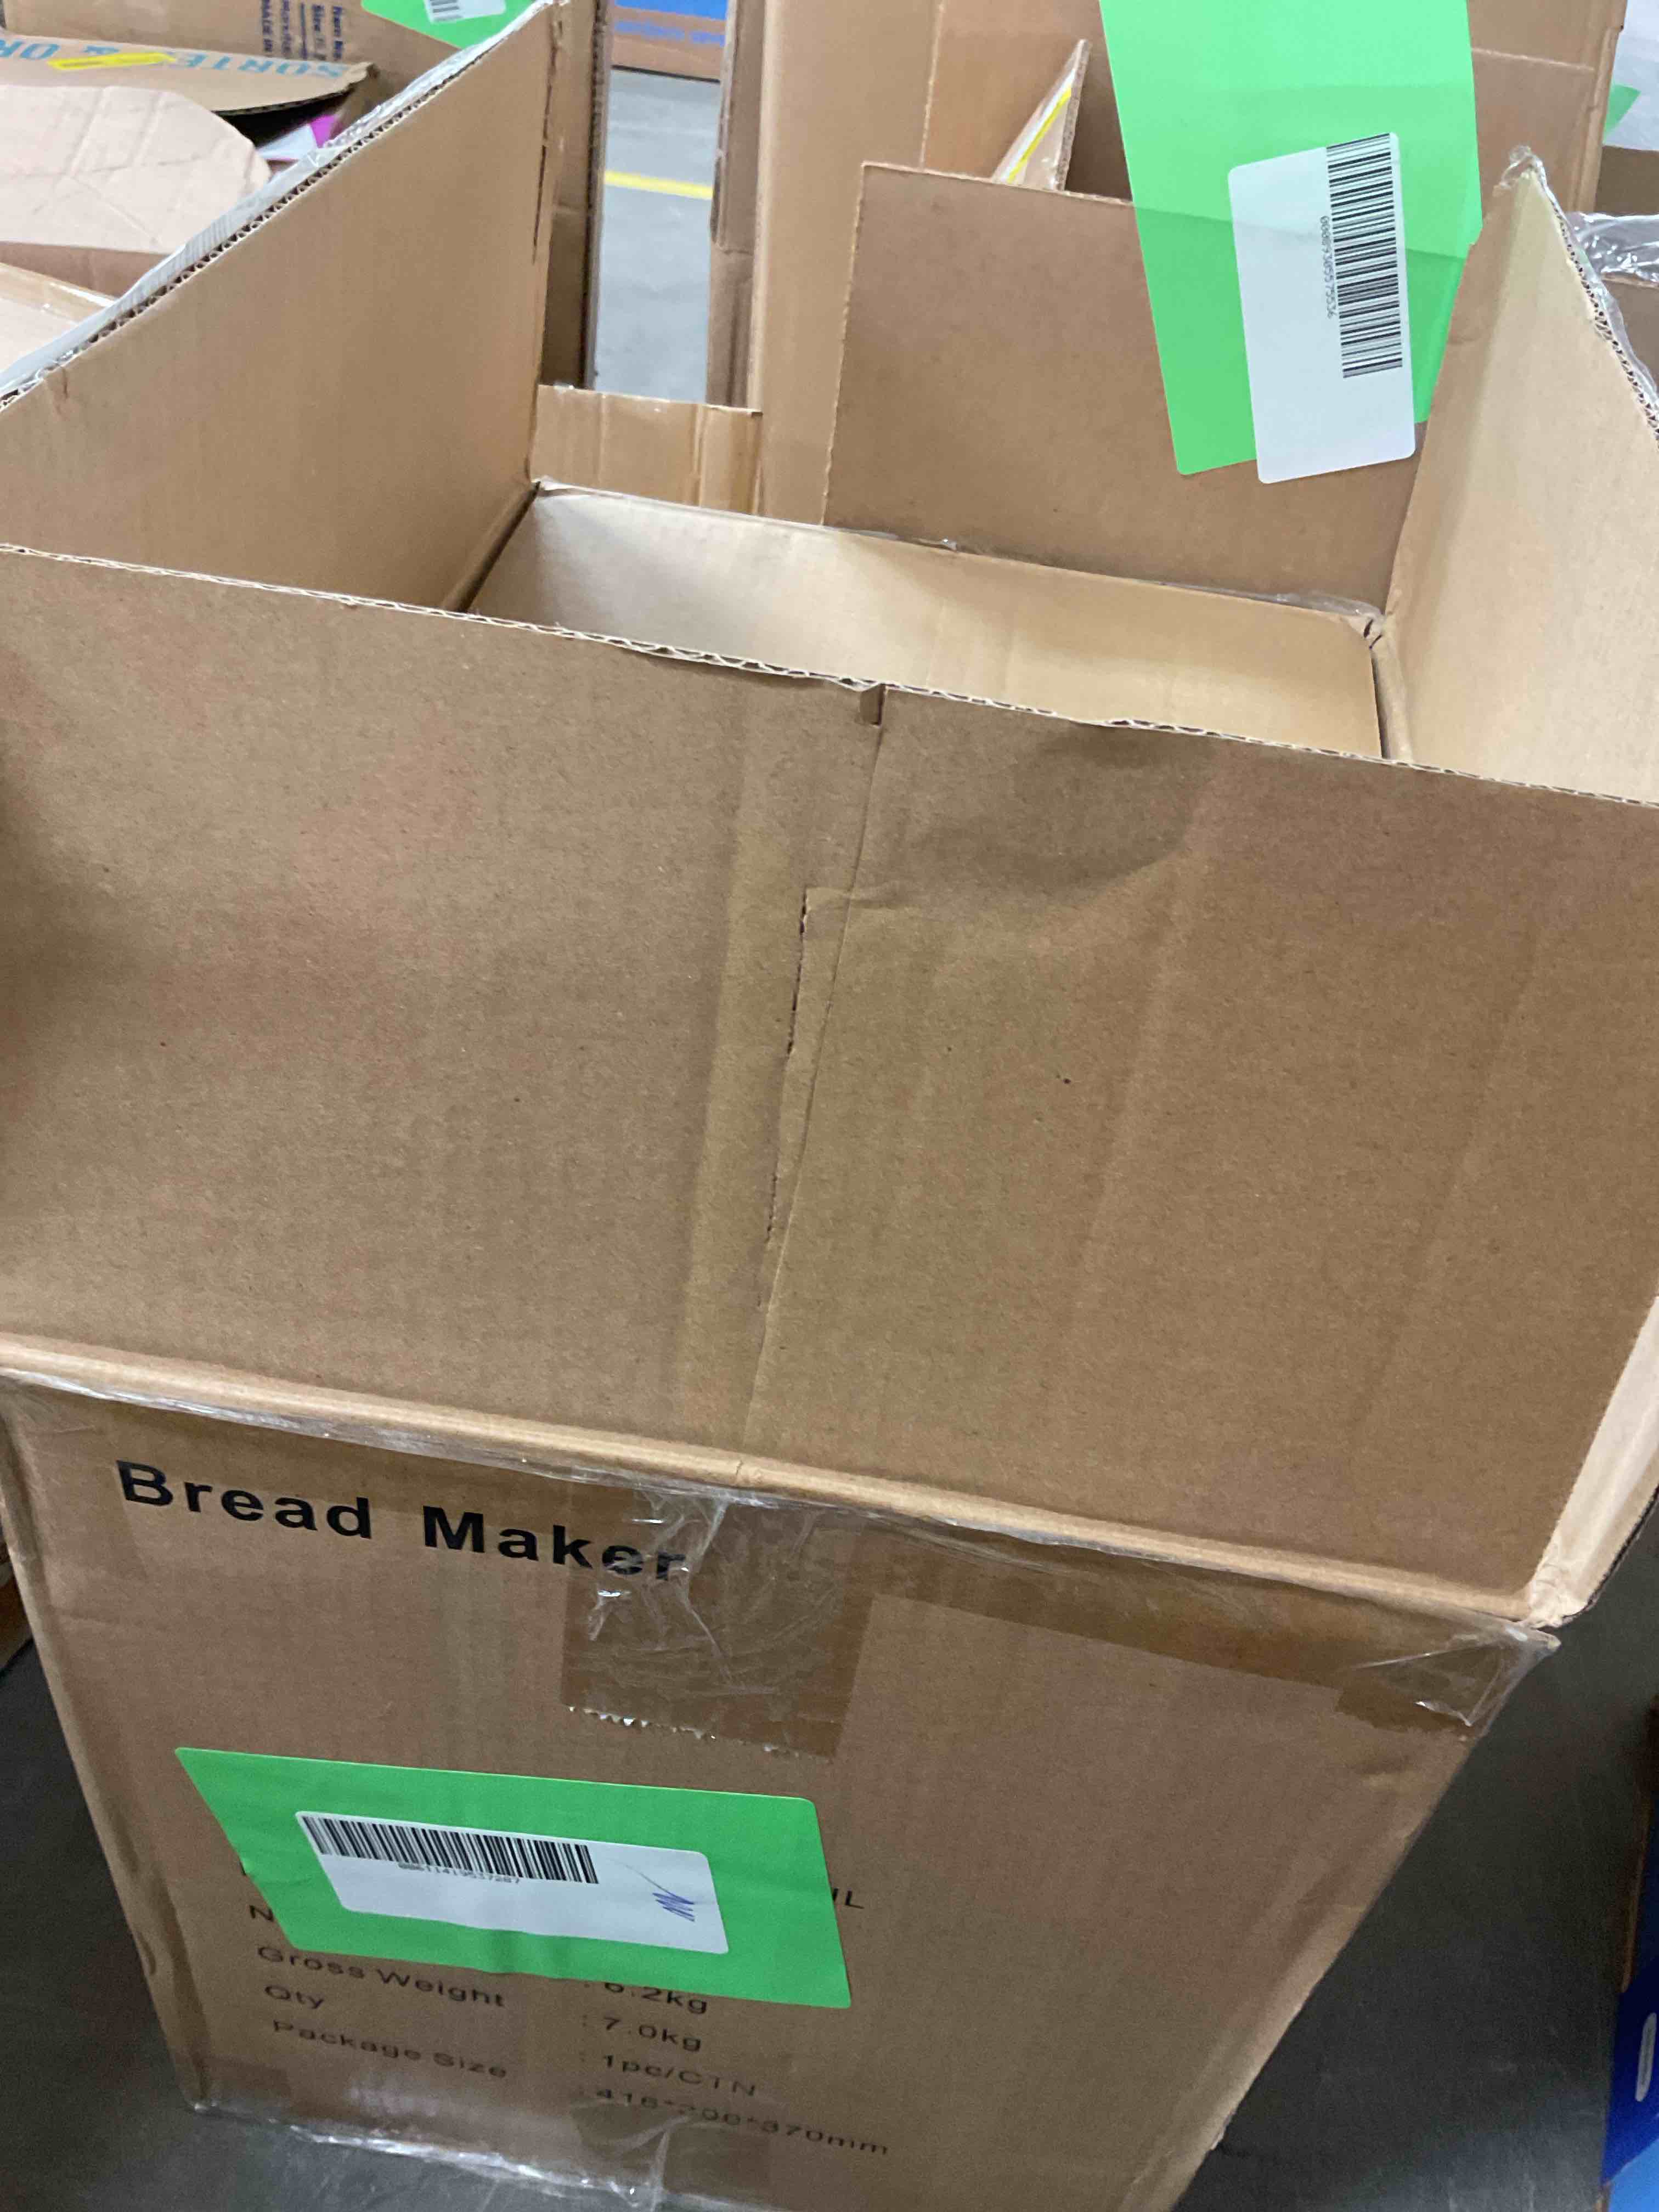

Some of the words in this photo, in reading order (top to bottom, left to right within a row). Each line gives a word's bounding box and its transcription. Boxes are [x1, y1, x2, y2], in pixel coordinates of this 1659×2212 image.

[116, 1460, 373, 1539] Bread
[422, 1505, 686, 1582] Maker
[257, 1945, 365, 1979] Gross
[377, 1968, 505, 2007] Weight
[603, 2017, 702, 2052] 7.0kg
[264, 1984, 324, 2010] Qty
[273, 2019, 422, 2061] Package
[433, 2051, 507, 2079] Size
